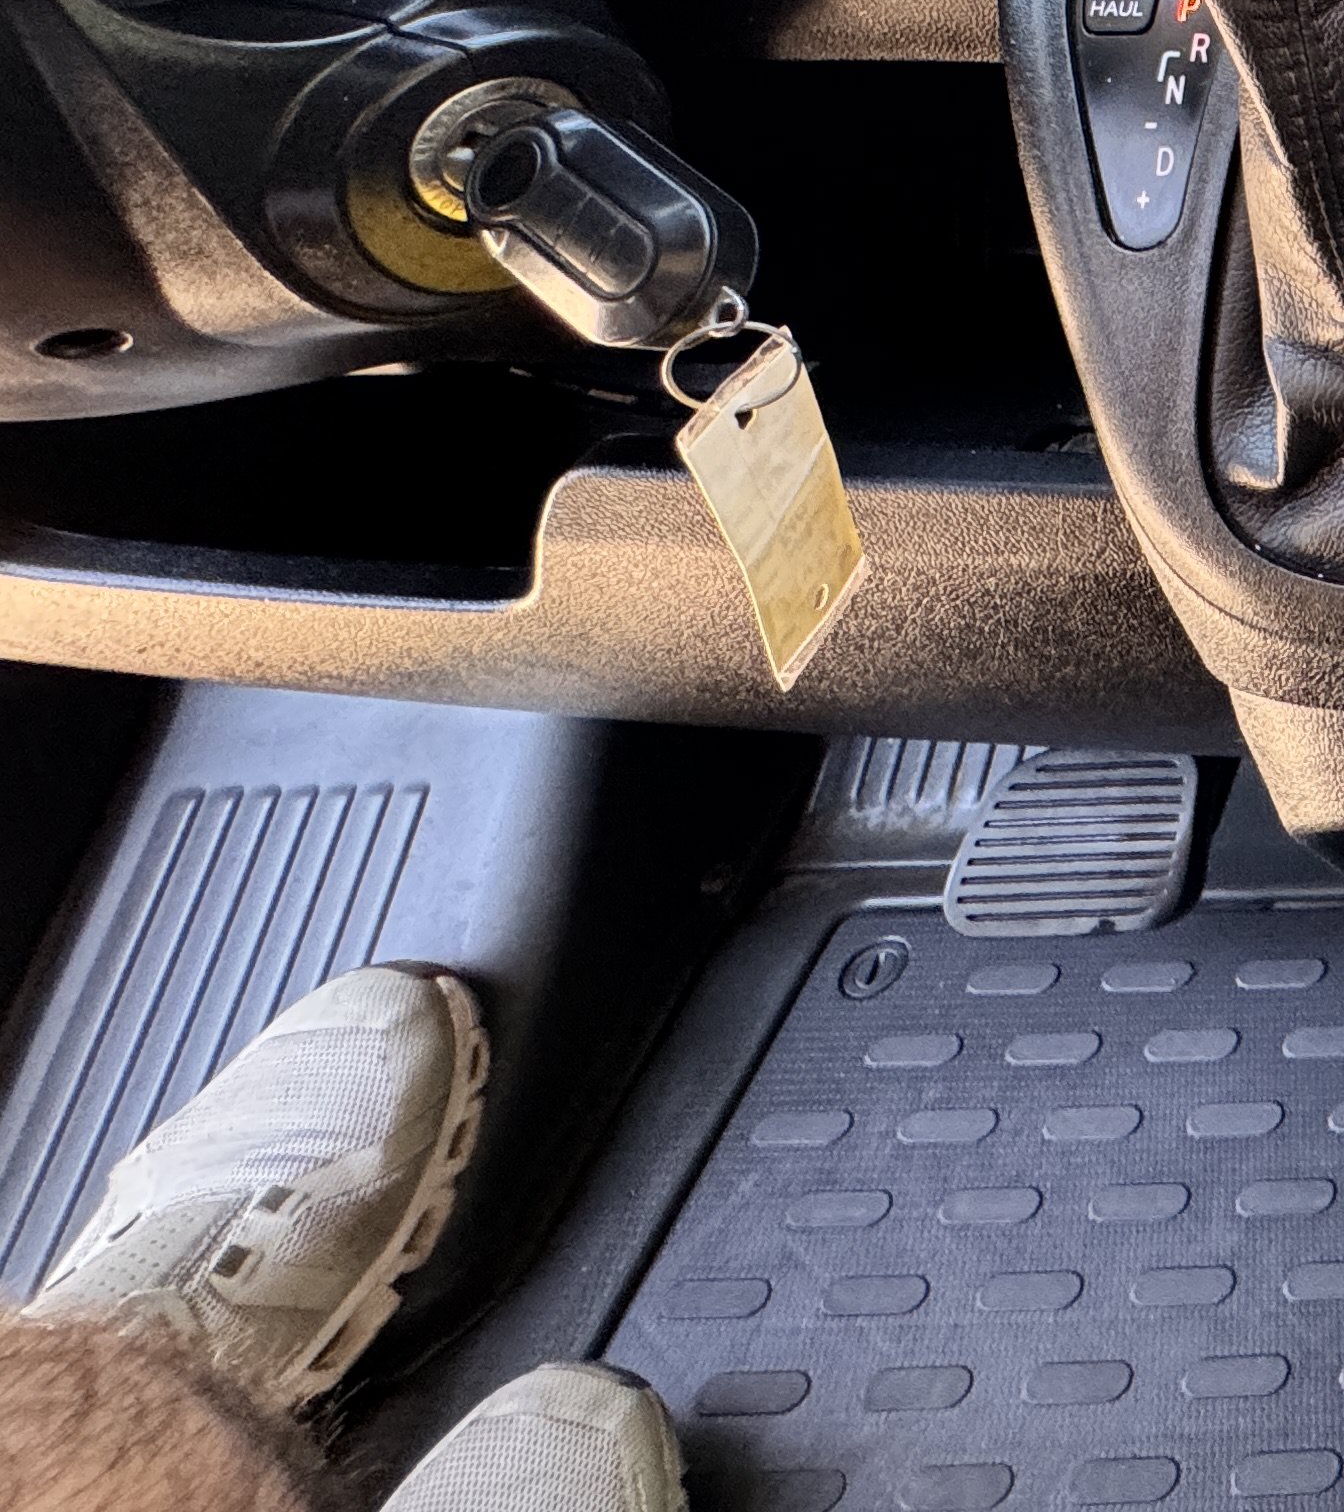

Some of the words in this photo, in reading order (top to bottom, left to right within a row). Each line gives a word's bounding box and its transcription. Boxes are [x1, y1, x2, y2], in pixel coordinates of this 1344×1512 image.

[1089, 0, 1144, 17] HAUL
[1189, 32, 1211, 64] R
[1164, 74, 1186, 105] N
[1156, 146, 1175, 177] D
